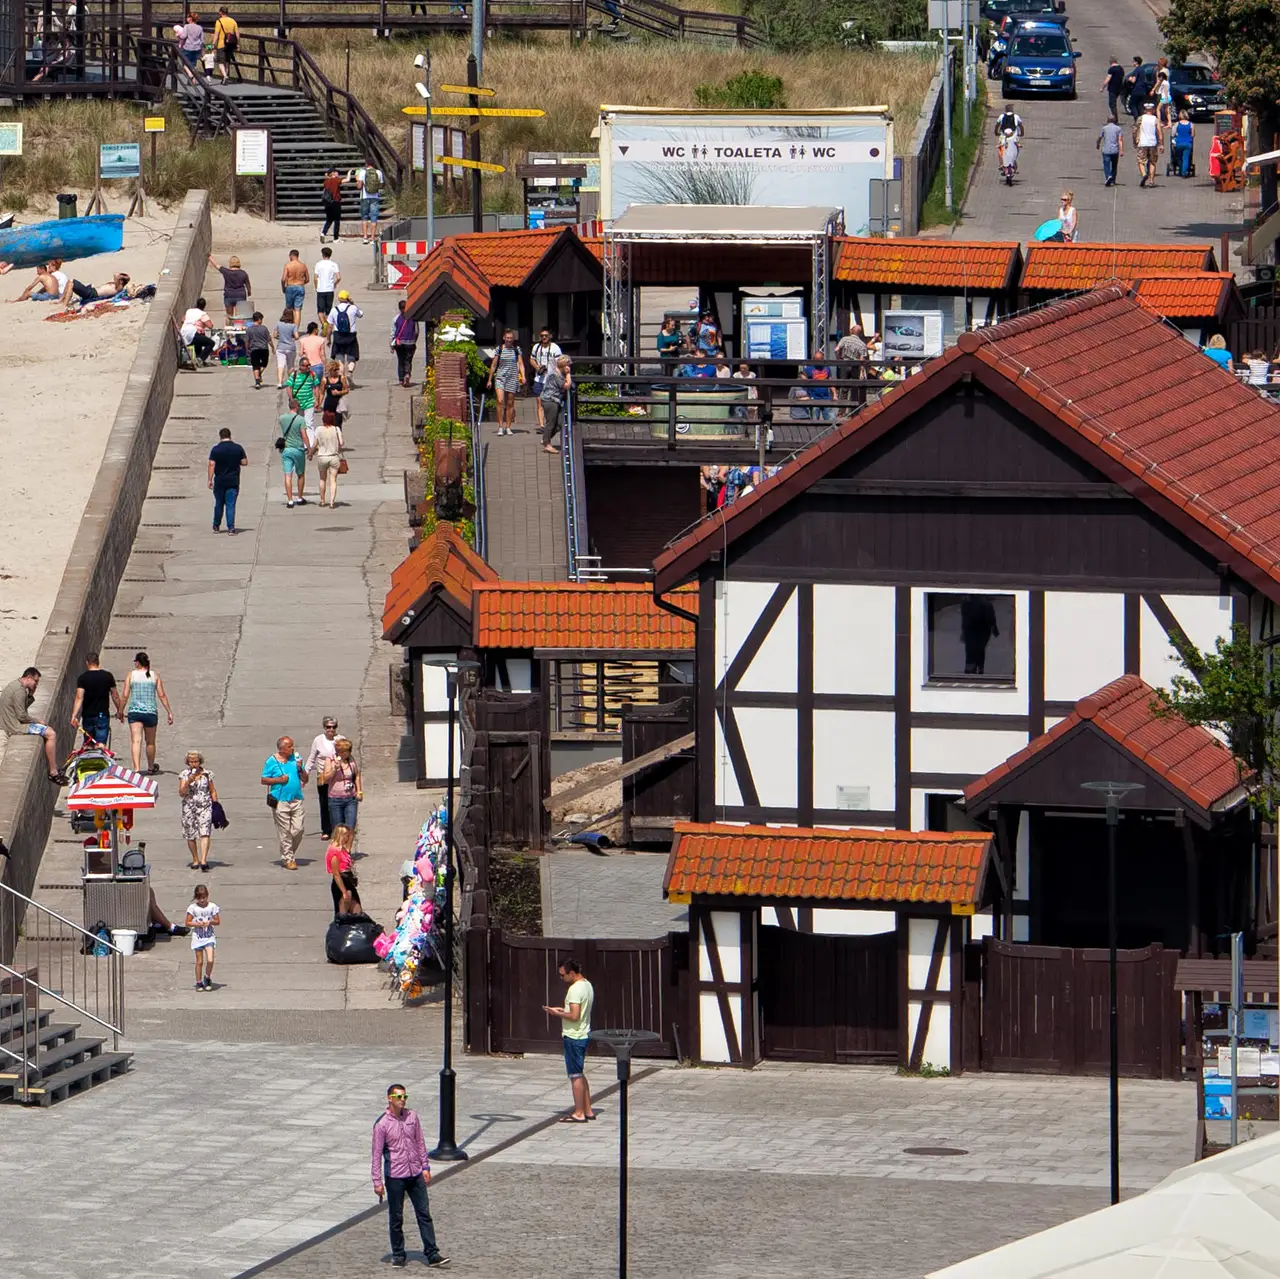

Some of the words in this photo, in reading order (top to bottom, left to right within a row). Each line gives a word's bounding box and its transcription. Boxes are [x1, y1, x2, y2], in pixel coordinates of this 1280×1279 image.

[662, 147, 685, 158] WC
[714, 147, 782, 158] TOALETA
[813, 147, 836, 158] WC
